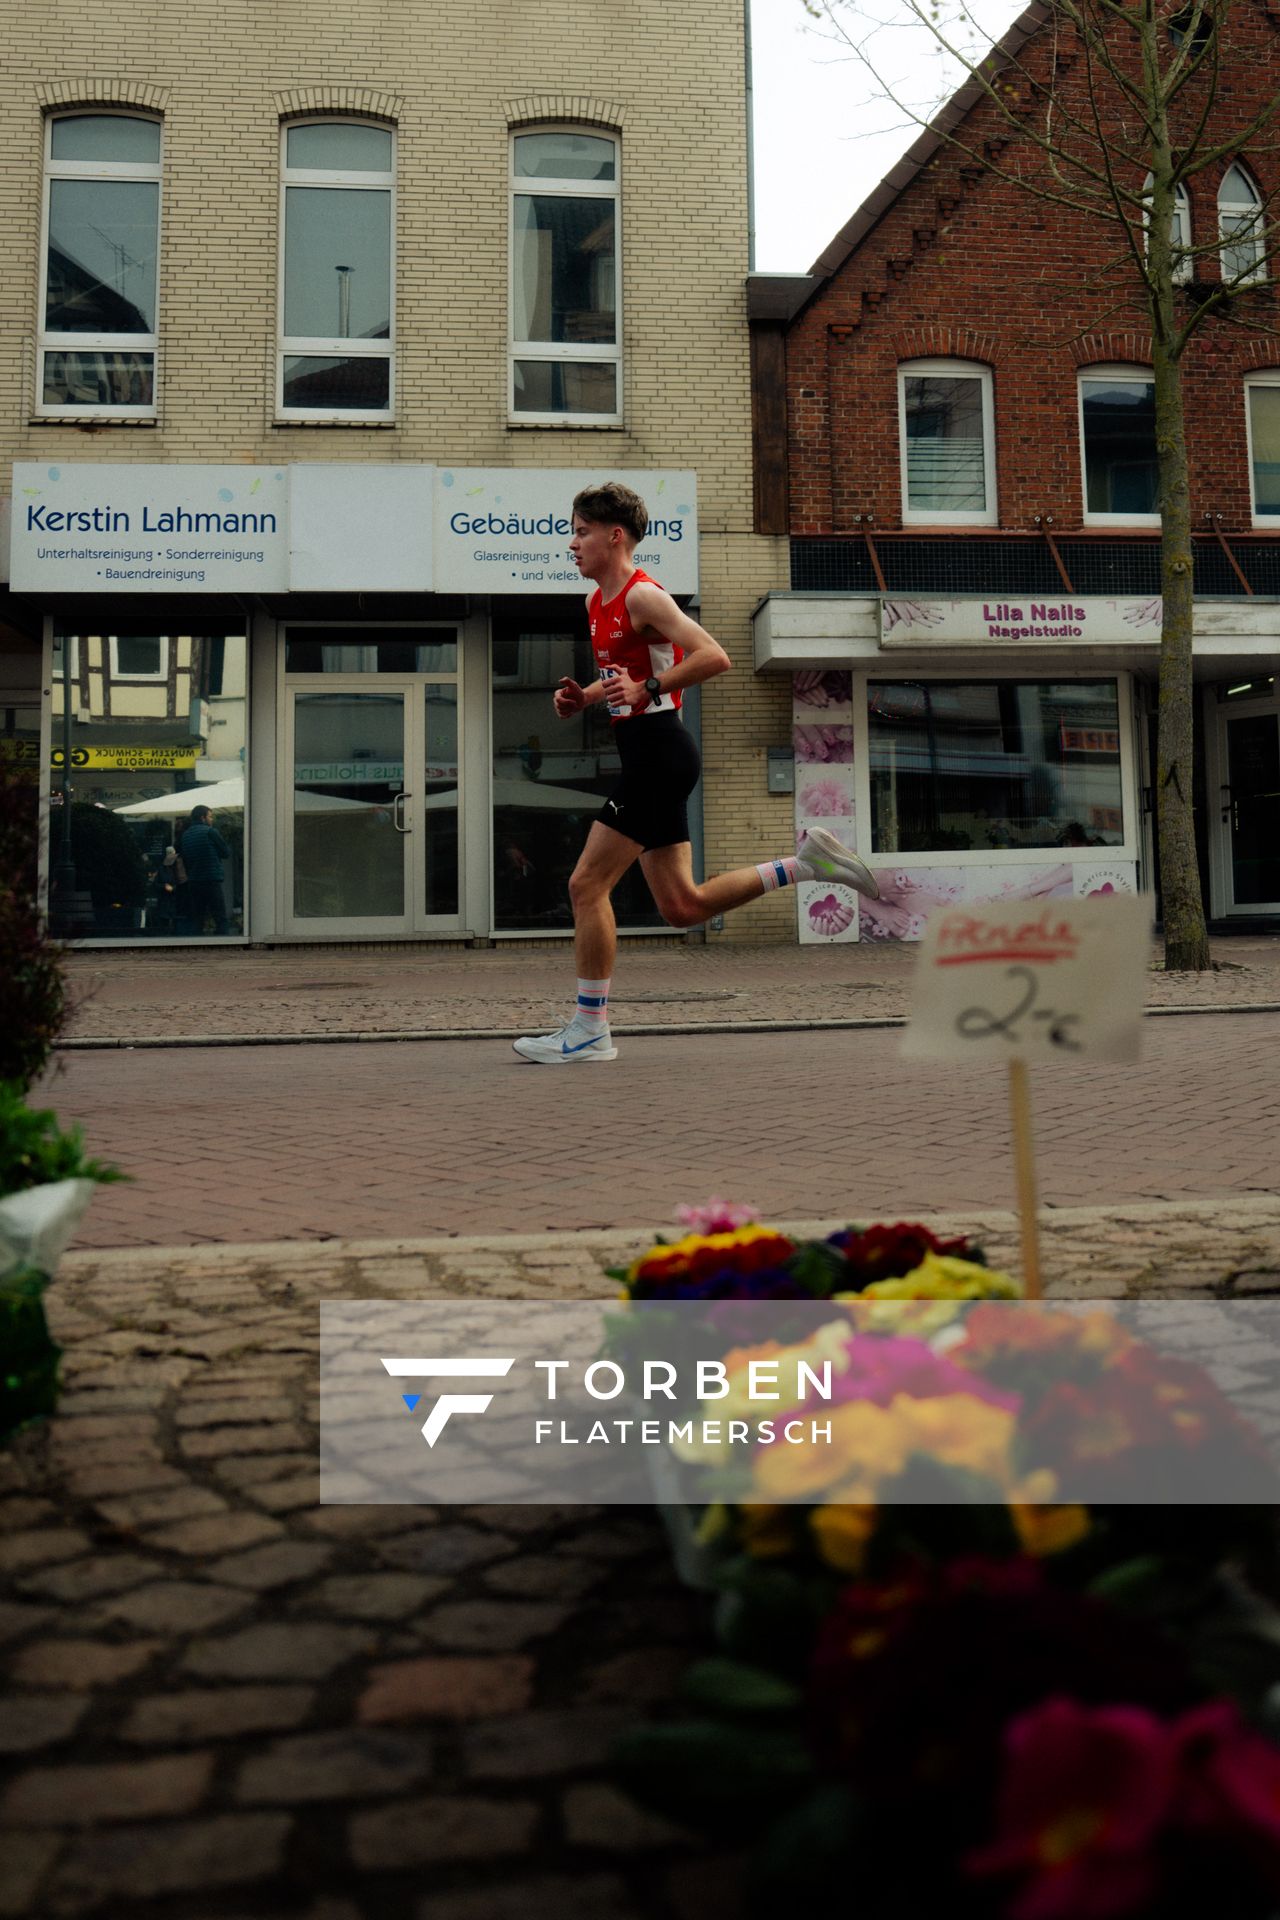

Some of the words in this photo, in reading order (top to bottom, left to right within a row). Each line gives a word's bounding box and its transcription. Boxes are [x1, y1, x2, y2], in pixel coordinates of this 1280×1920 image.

[27, 505, 129, 532] Kerstin
[142, 506, 276, 533] Lahmann
[37, 548, 153, 562] Unterhaltsreinigung
[166, 548, 264, 562] Sonderreinigung
[473, 550, 550, 564] Glasreinigung
[105, 568, 205, 581] Bauendreinigung
[521, 570, 544, 581] und
[546, 570, 579, 581] vieles
[982, 604, 1024, 621] Lila
[1030, 604, 1087, 621] Nails
[988, 625, 1082, 640] Nagelstudio
[1079, 870, 1113, 895] American
[803, 884, 836, 905] American
[838, 886, 853, 904] Style
